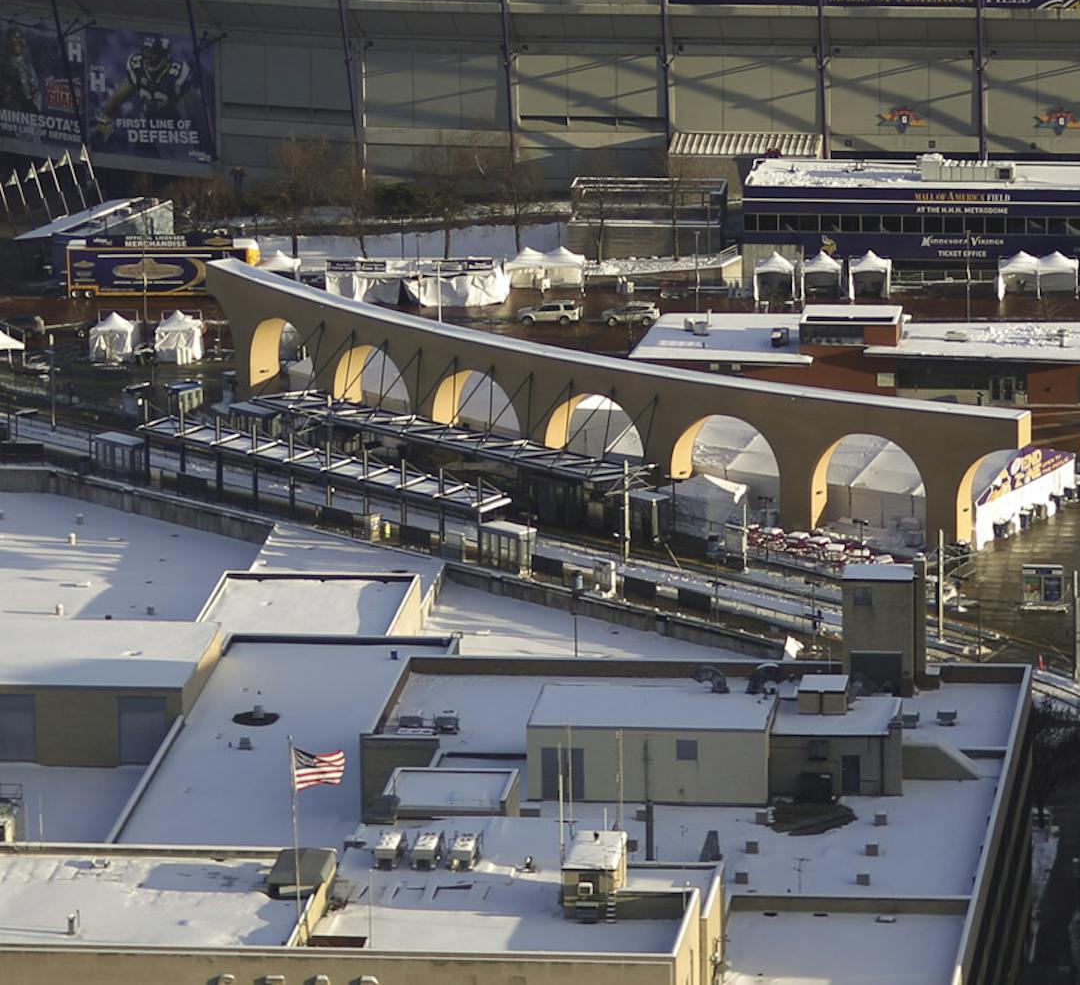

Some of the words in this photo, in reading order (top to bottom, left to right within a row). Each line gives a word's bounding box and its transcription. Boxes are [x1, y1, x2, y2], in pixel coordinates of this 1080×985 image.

[68, 42, 82, 62] H
[90, 72, 106, 92] H
[116, 118, 146, 129] FIRST
[150, 118, 174, 129] LINE
[177, 120, 192, 130] OF
[127, 130, 199, 144] DEFENSE
